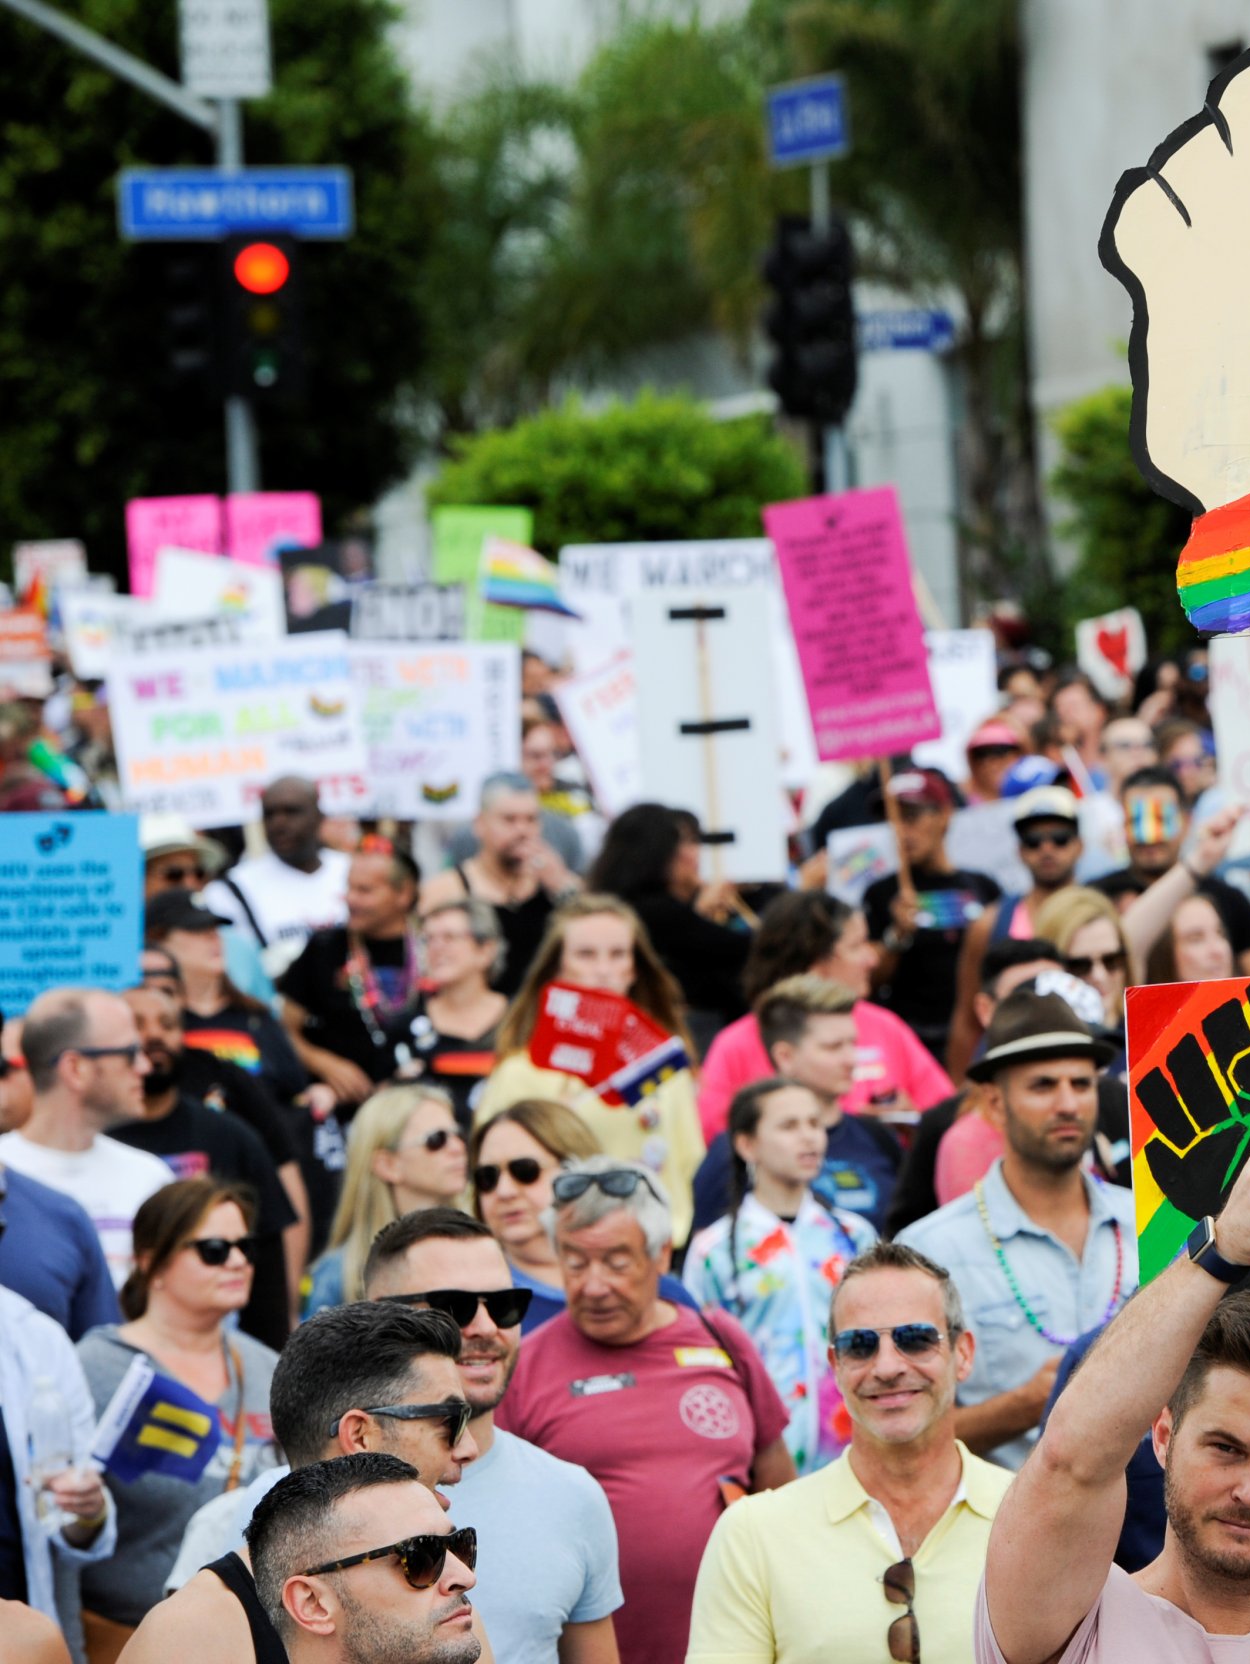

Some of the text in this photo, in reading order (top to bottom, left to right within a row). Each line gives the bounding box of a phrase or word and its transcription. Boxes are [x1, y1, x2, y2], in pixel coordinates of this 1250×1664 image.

[132, 670, 182, 699] WE
[215, 657, 349, 690] MARCH
[152, 700, 298, 743] FOR ALL
[131, 748, 266, 785] HUMAN
